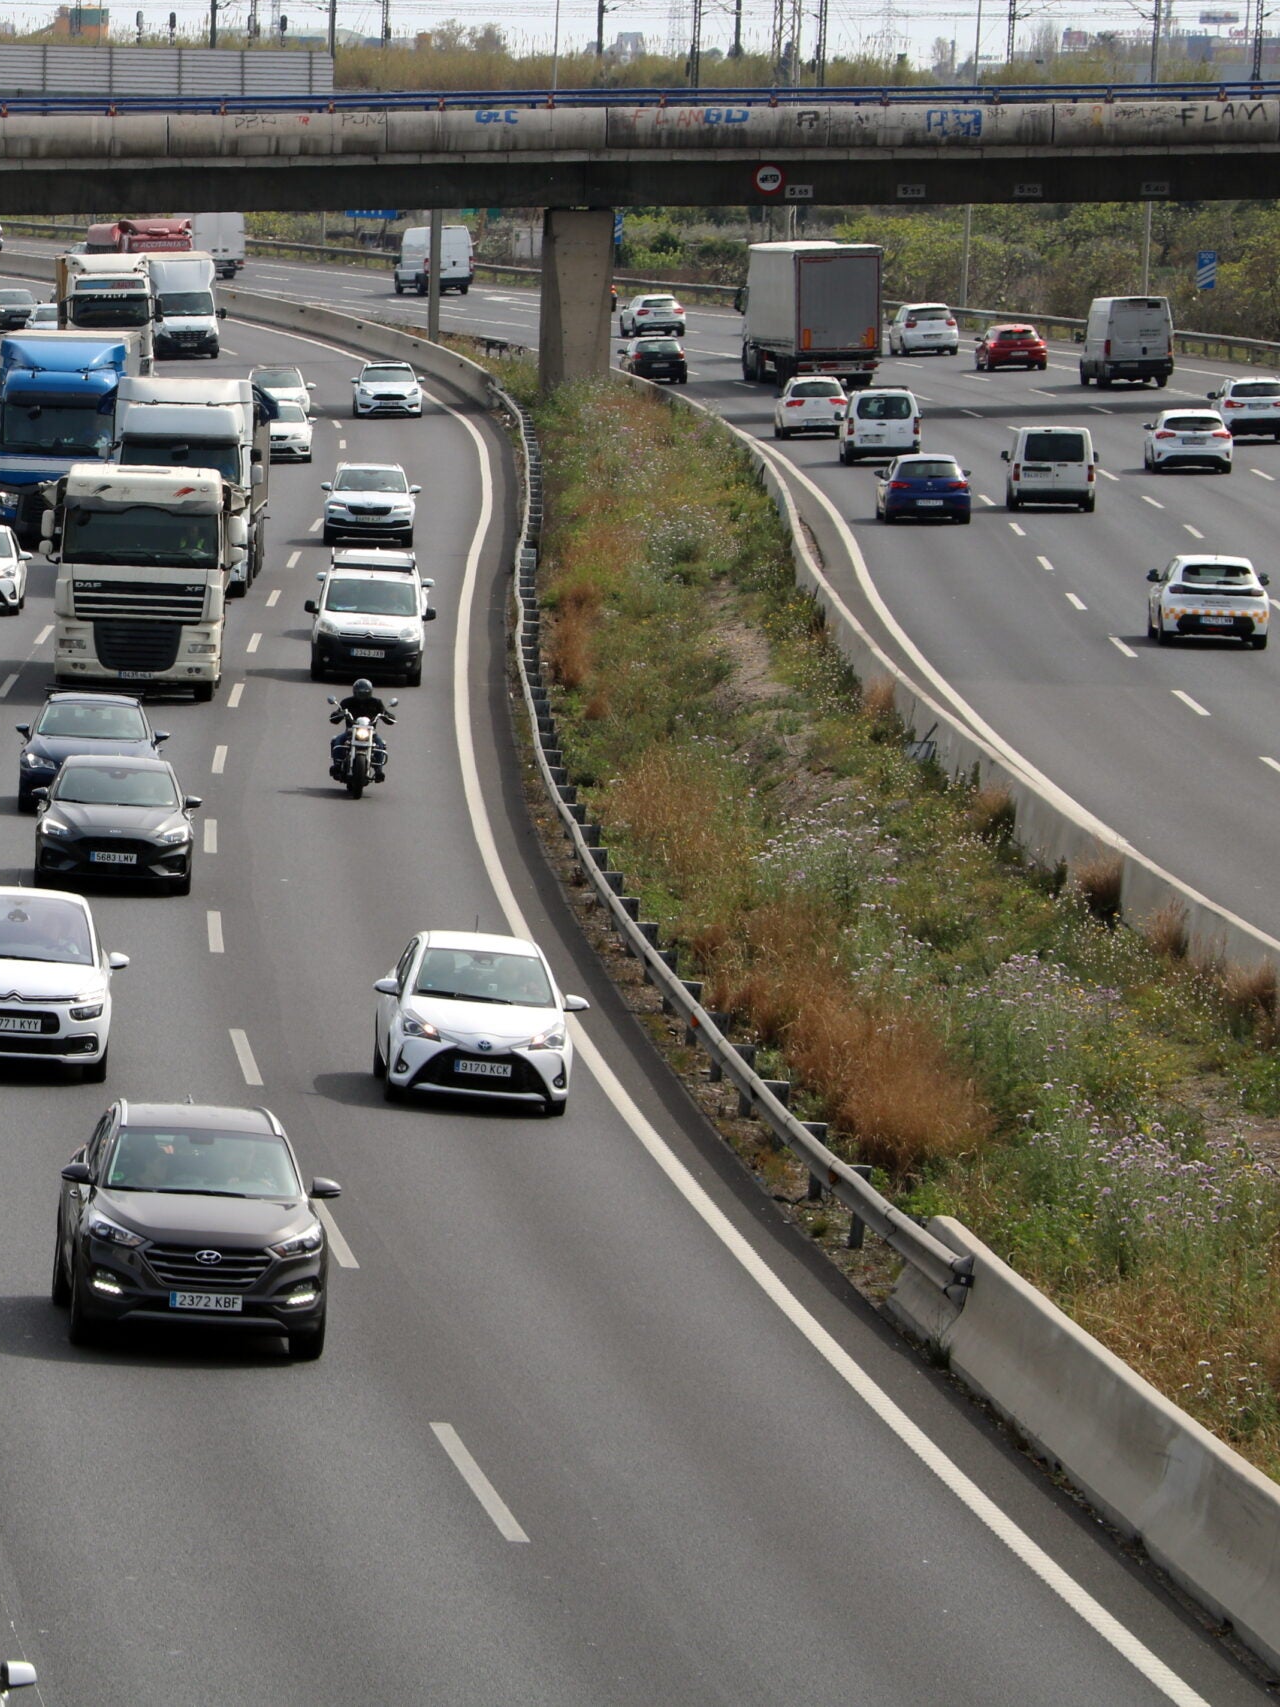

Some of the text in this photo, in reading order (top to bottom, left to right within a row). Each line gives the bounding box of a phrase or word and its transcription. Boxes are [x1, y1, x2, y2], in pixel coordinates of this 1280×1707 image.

[74, 581, 103, 589] DAF
[184, 585, 205, 594] XF
[20, 1020, 39, 1030] KYY
[461, 1062, 509, 1075] 9170 KCK
[179, 1294, 240, 1309] 2372 KBF
